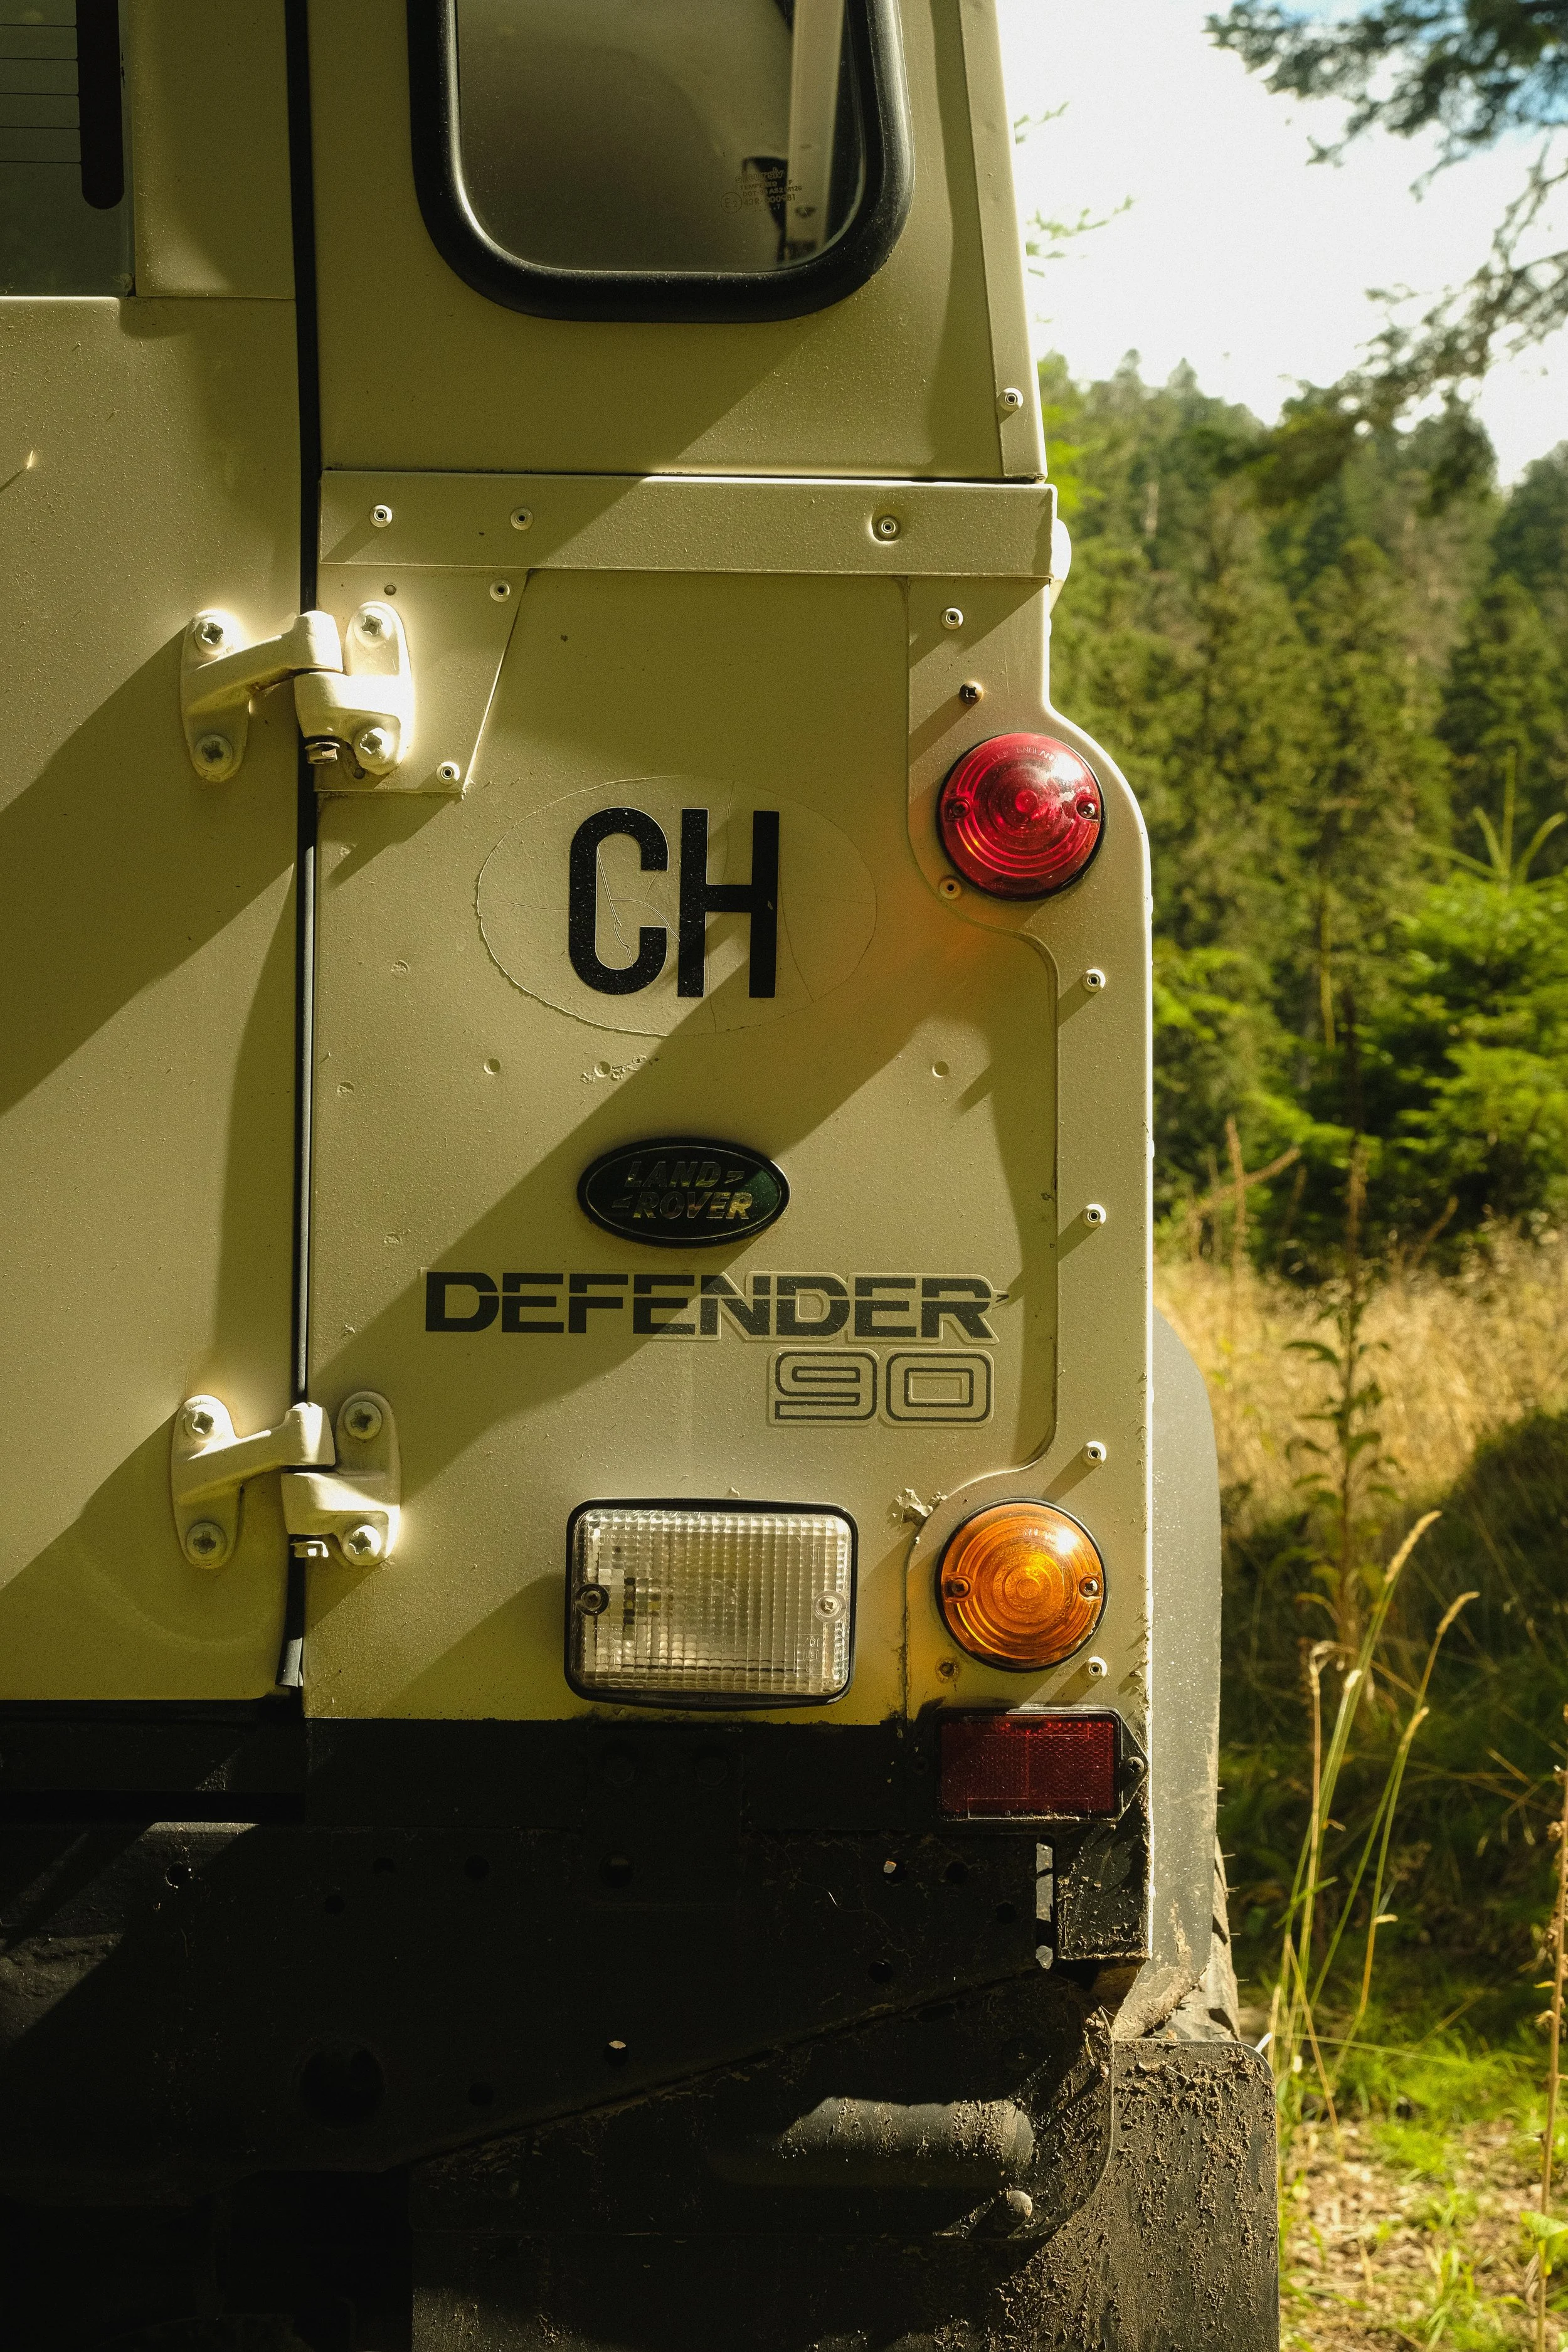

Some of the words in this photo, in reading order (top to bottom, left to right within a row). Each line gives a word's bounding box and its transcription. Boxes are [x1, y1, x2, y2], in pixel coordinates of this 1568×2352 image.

[569, 807, 779, 998] CH
[624, 1161, 722, 1188] LAND
[633, 1192, 753, 1219] ROVER
[425, 1271, 993, 1338] DEFENDER
[775, 1351, 991, 1422] 90
